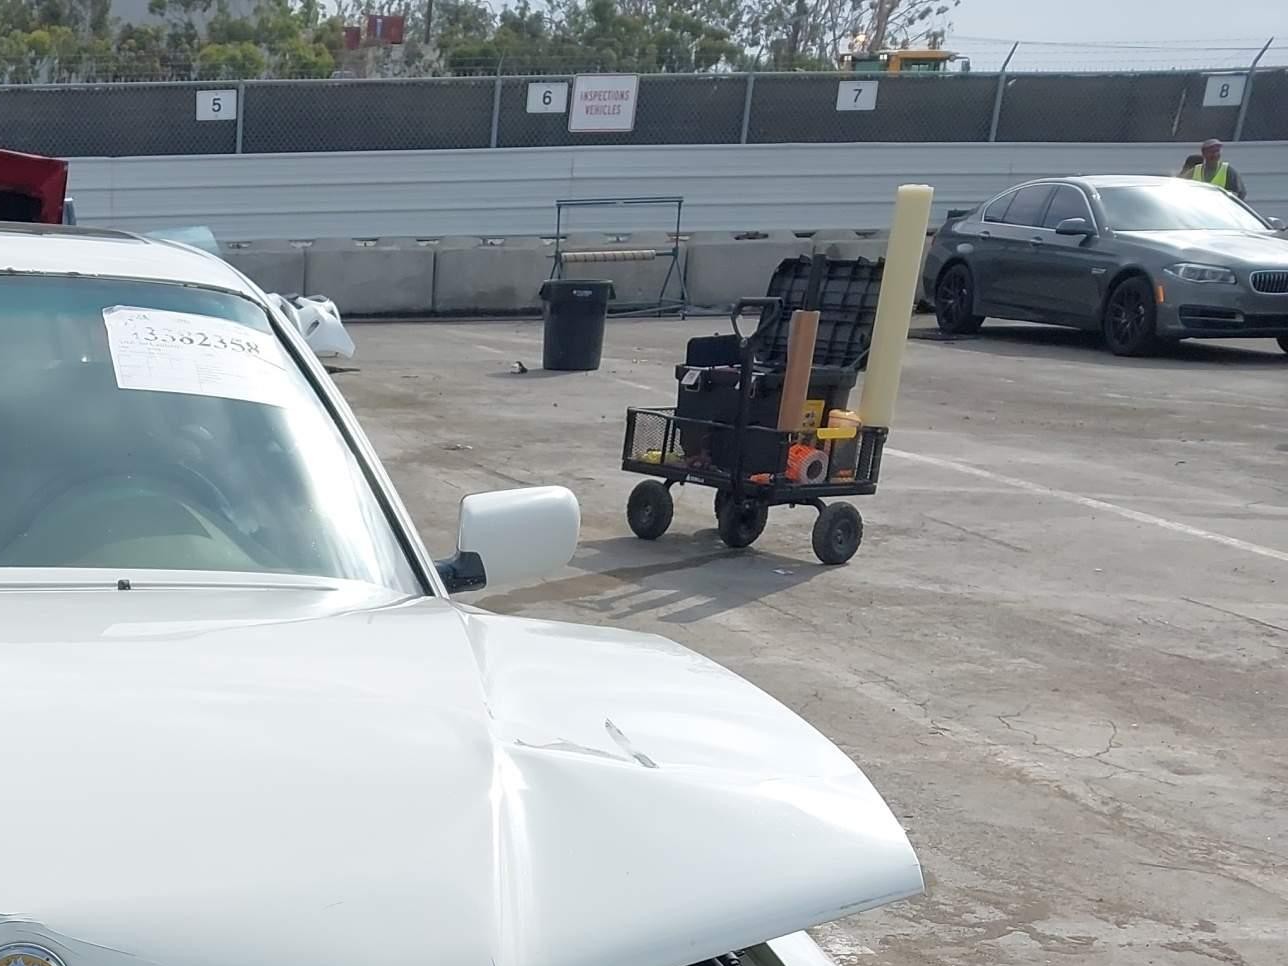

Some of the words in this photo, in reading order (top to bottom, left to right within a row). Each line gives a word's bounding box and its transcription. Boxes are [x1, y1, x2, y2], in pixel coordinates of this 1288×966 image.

[542, 90, 552, 105] 6
[580, 90, 630, 102] INSPECTIONS
[853, 88, 863, 103] 7
[1219, 83, 1230, 98] 8
[212, 97, 222, 113] 5
[585, 104, 621, 115] VEHICLES
